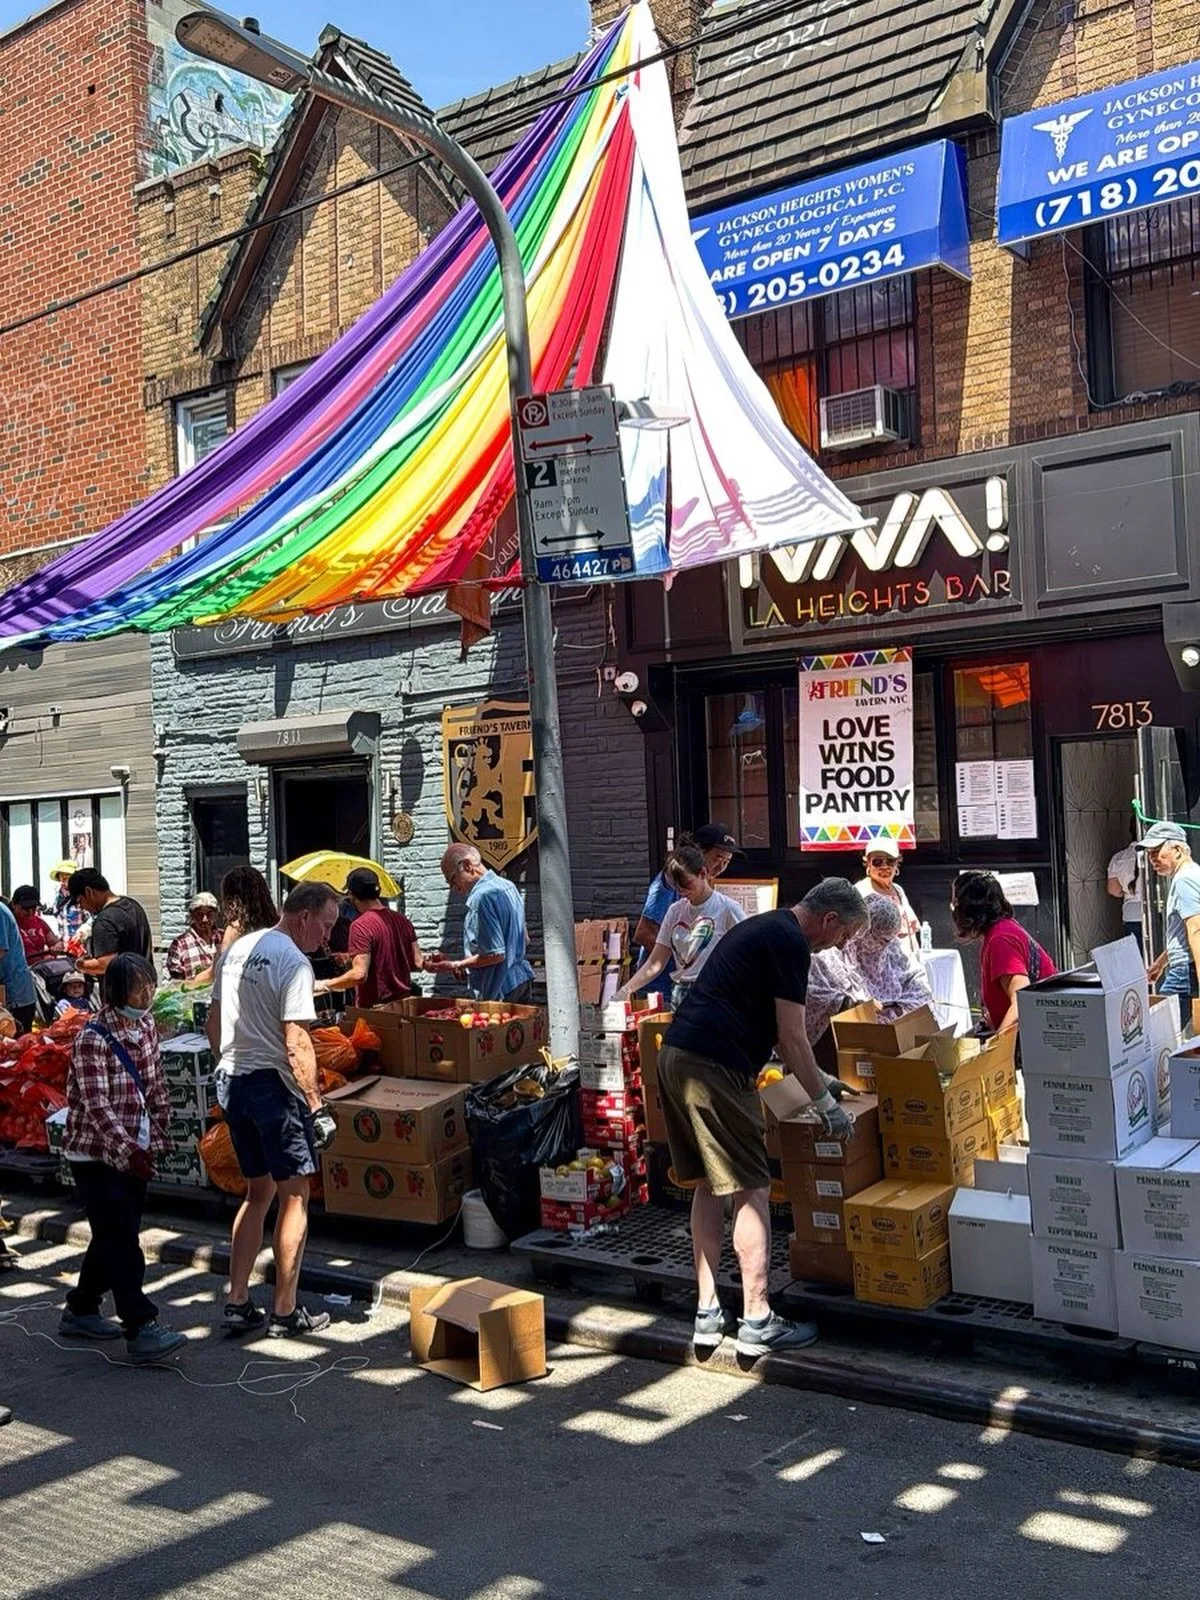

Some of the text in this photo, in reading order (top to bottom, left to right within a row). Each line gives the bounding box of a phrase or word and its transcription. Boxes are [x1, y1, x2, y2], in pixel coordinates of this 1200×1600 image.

[1103, 79, 1185, 115] JACKSON
[1116, 130, 1150, 146] More
[1154, 119, 1183, 135] than
[1048, 161, 1089, 185] WE
[1097, 144, 1149, 172] ARE
[716, 163, 915, 234] JACKSON HEIGHTS WOMEN'S
[1035, 178, 1138, 228] (718)
[718, 182, 905, 248] GYNECOLOGICAL P.C.
[723, 204, 897, 262] More than 20 Years of Experience
[709, 217, 897, 283] ARE OPEN 7 DAYS
[748, 243, 905, 308] 205-0234
[533, 462, 550, 486] 2
[534, 499, 553, 510] 9am
[560, 496, 580, 507] 7pm
[535, 505, 599, 521] Except Sunday
[552, 559, 609, 580] 464427
[750, 570, 1011, 628] LA HEIGHTS BAR
[854, 694, 908, 708] TAVERN NYC
[823, 715, 891, 741] LOVE
[1092, 701, 1153, 730] 7813
[276, 730, 301, 745] 7811
[459, 722, 499, 736] FRIEND'S
[818, 740, 895, 764] WINS
[820, 765, 895, 790] FOOD
[805, 789, 911, 814] PANTRY
